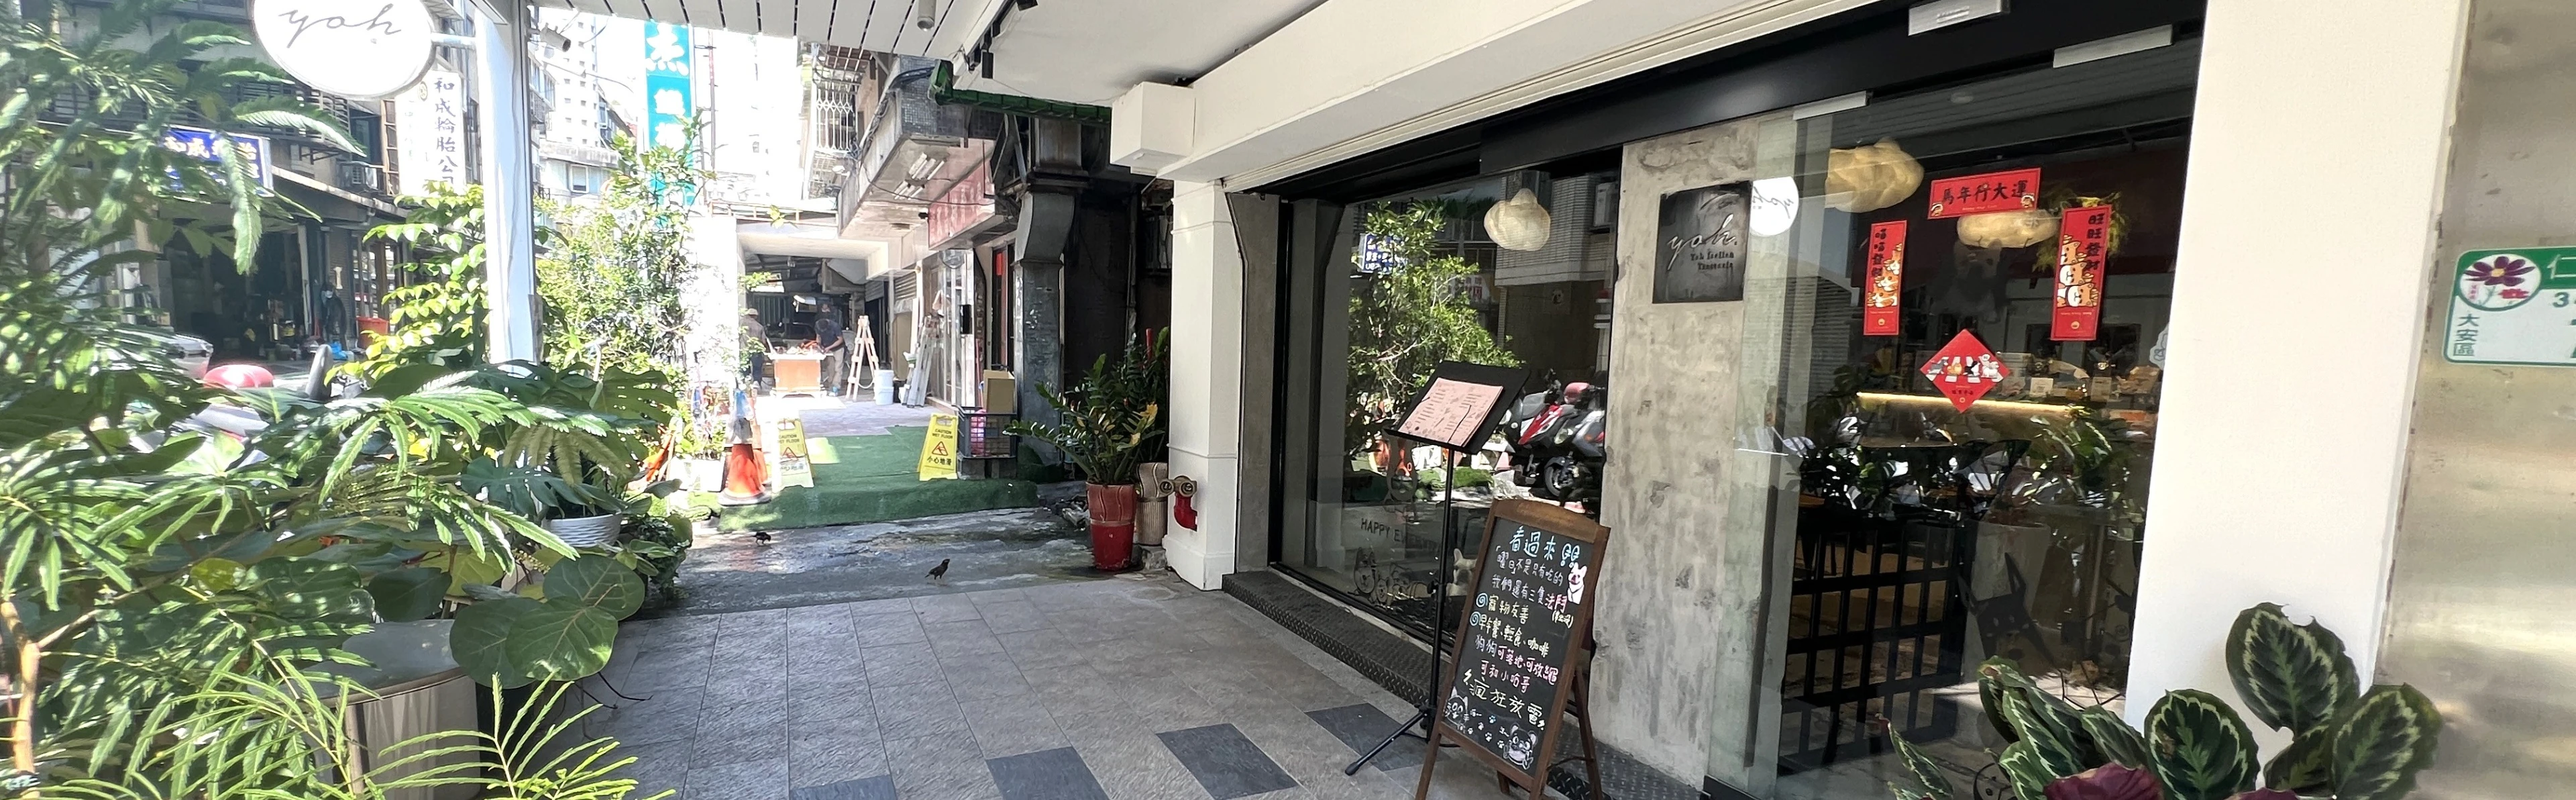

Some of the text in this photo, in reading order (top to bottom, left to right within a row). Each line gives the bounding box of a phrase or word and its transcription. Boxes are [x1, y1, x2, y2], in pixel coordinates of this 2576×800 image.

[278, 3, 402, 48] yoh
[1942, 180, 2028, 205] 馬年行大運
[2453, 313, 2480, 356] 大安區
[927, 456, 952, 465] 小心地滑
[1360, 518, 1390, 538] HAPPY
[1489, 594, 1529, 624] 寵物友善
